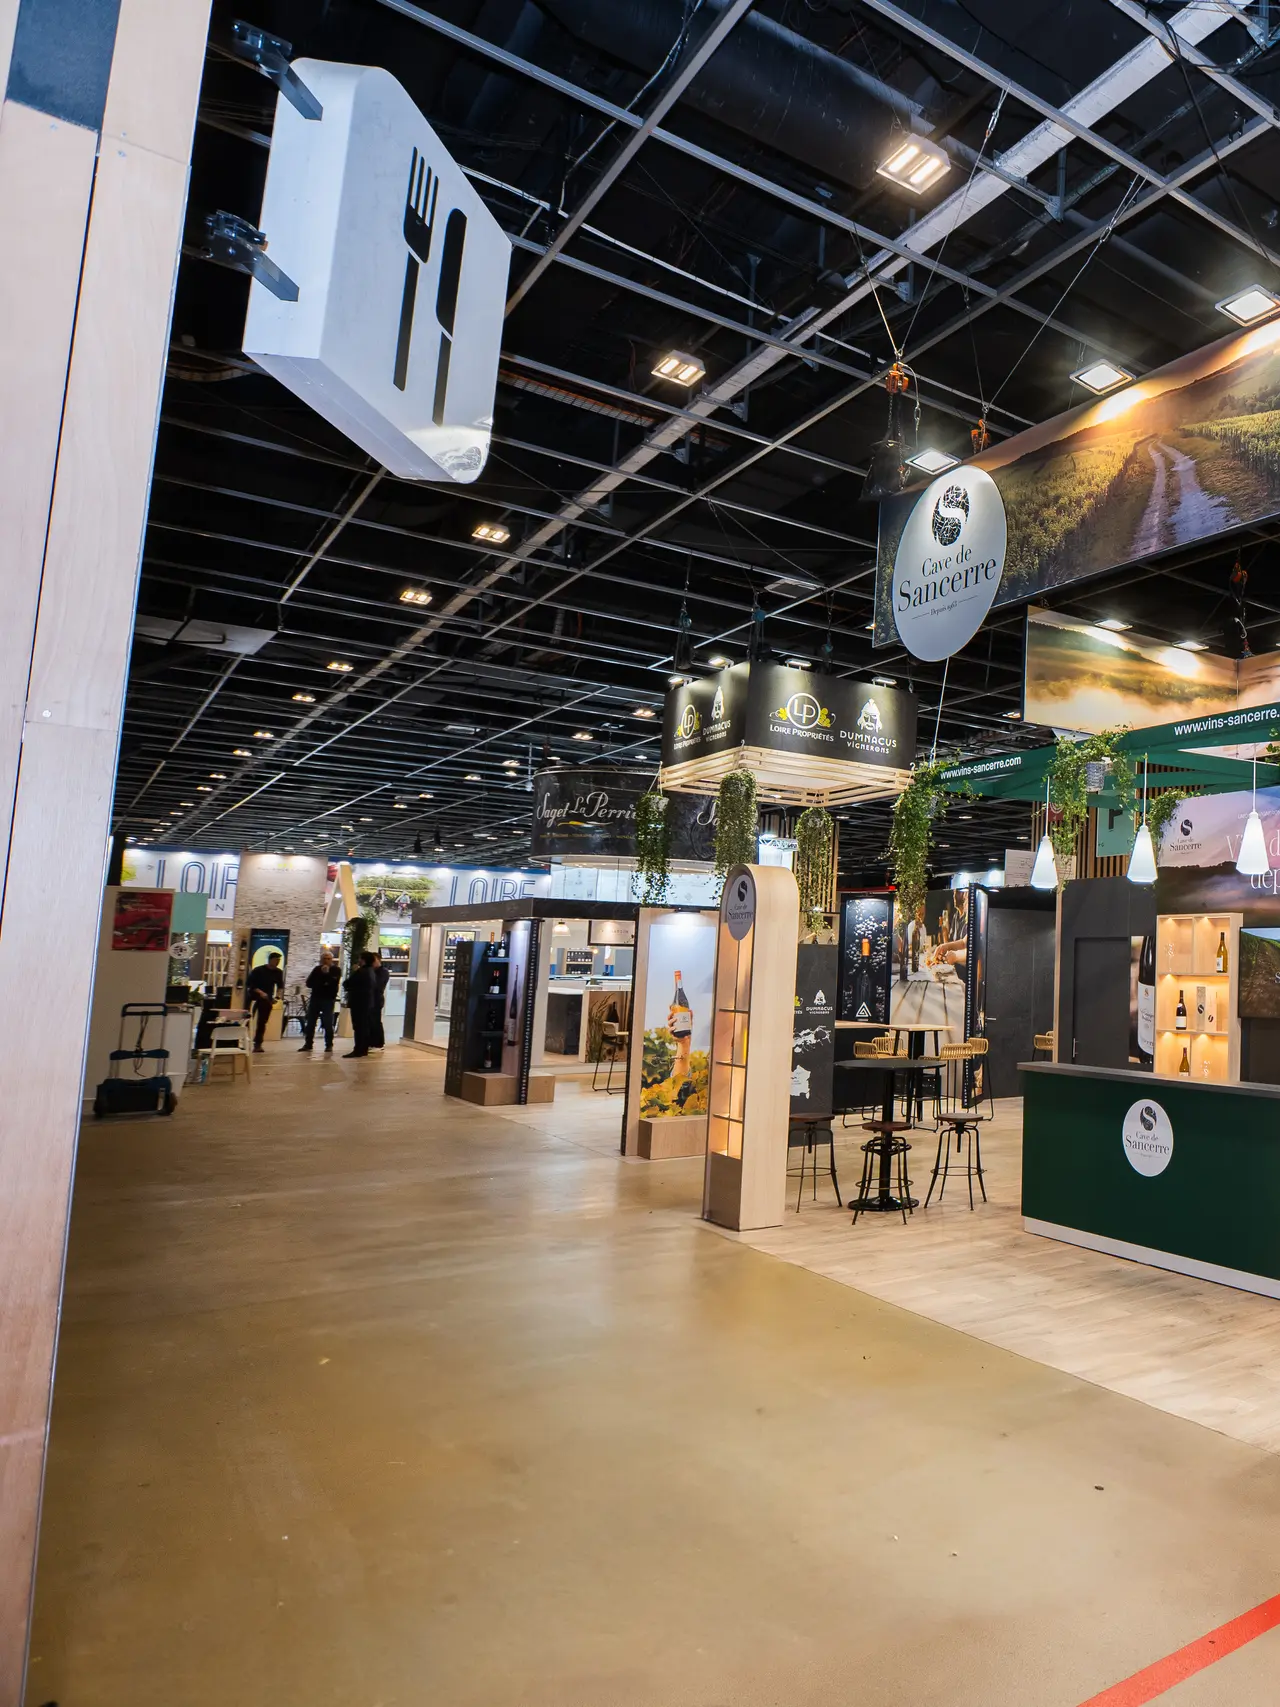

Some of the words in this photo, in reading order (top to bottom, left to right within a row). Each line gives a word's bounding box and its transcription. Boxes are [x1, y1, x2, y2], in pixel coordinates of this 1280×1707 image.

[922, 556, 952, 578] Cave
[956, 545, 972, 565] de
[897, 558, 997, 612] Sancerre
[702, 720, 731, 736] DUMNACUS
[769, 724, 792, 735] LOIRE
[792, 728, 835, 742] PROPRIÉTÉS
[840, 730, 897, 748] DUMNACUS
[940, 755, 1022, 780] www.vins-sancerre.com
[536, 792, 570, 828] Saget
[568, 796, 586, 815] La
[584, 791, 636, 820] Perri
[1169, 843, 1202, 851] Sancerre
[1125, 1134, 1170, 1155] Sancerre
[1136, 1131, 1150, 1140] Cave
[1151, 1133, 1159, 1141] de
